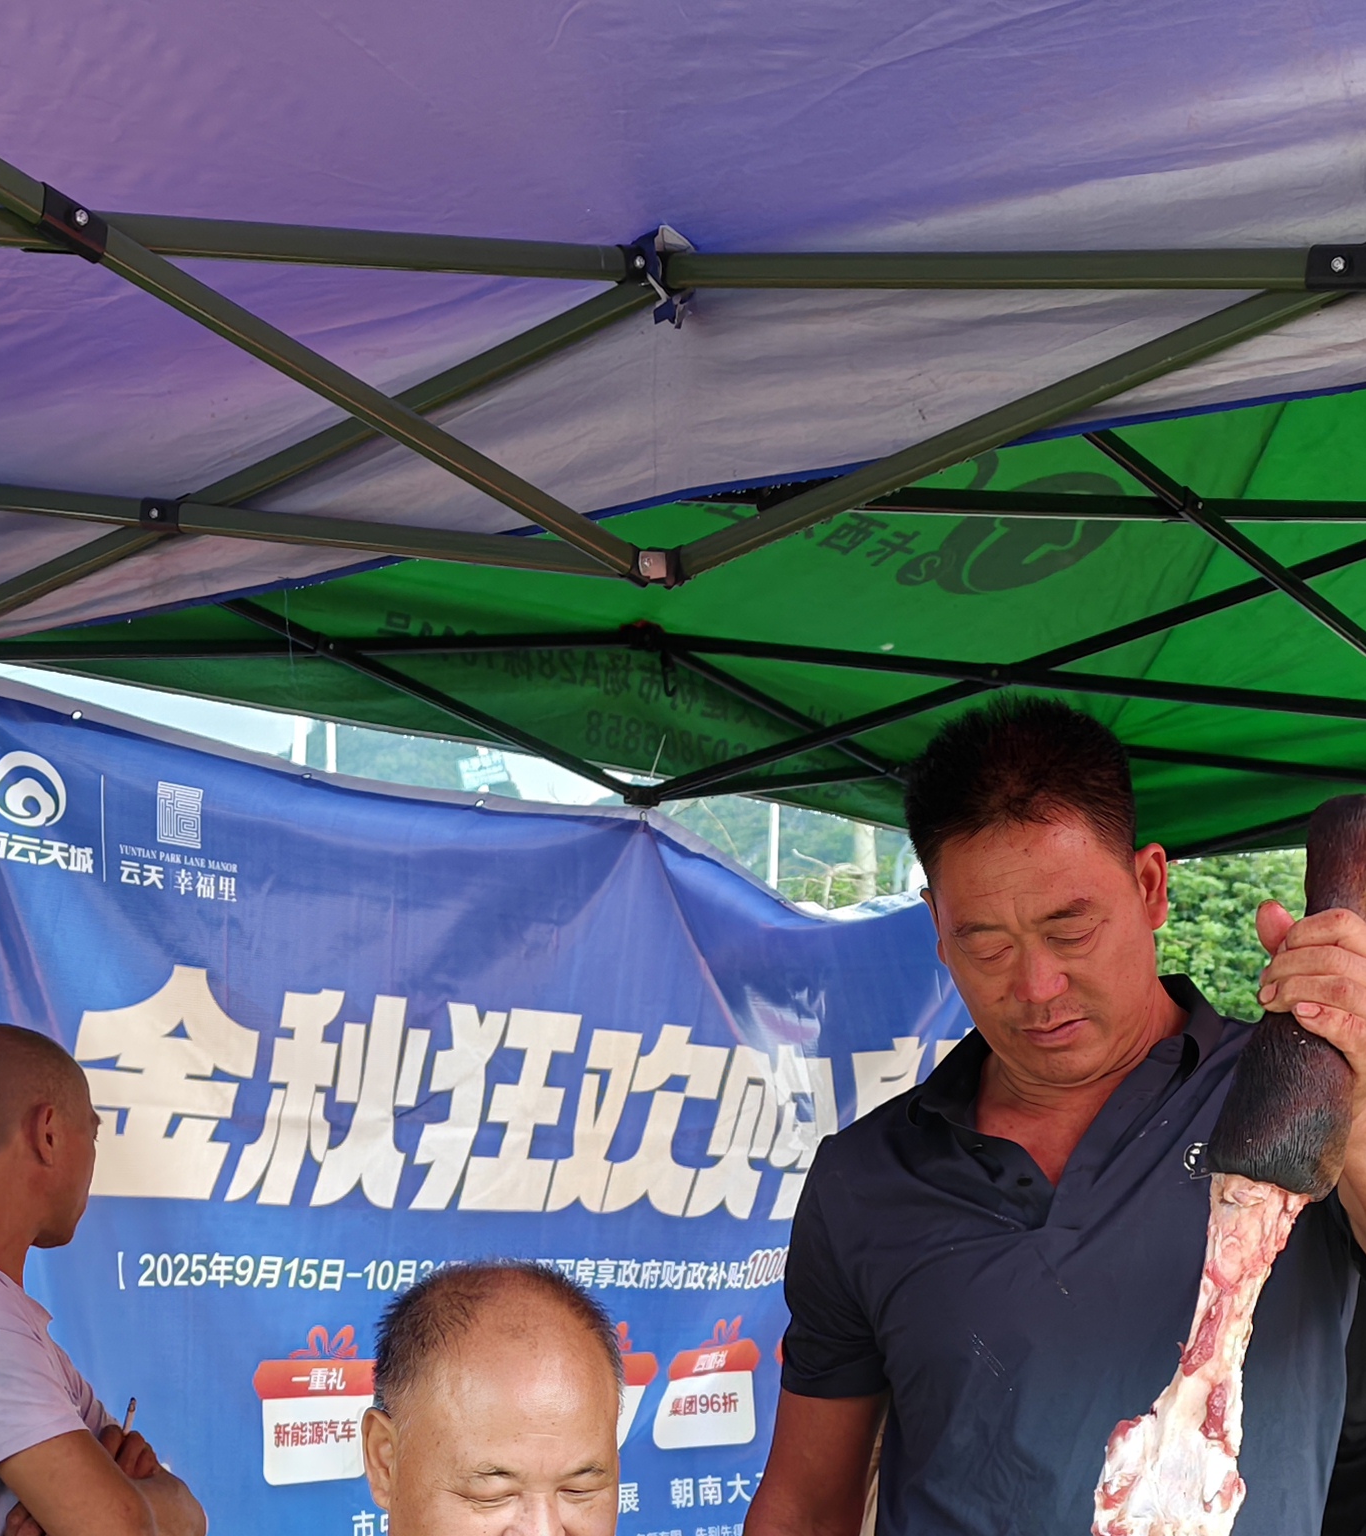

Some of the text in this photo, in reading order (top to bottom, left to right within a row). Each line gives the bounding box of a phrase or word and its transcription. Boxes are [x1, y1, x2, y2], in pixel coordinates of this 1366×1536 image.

[119, 844, 238, 873] YUNTIAN PARK LANE MANOR
[119, 860, 237, 902] 云天 幸福里
[73, 963, 975, 1220] 金秋狂欢购
[291, 1367, 346, 1392] 一重礼
[668, 1392, 739, 1416] 集团96折
[273, 1419, 358, 1448] 新能源汽车
